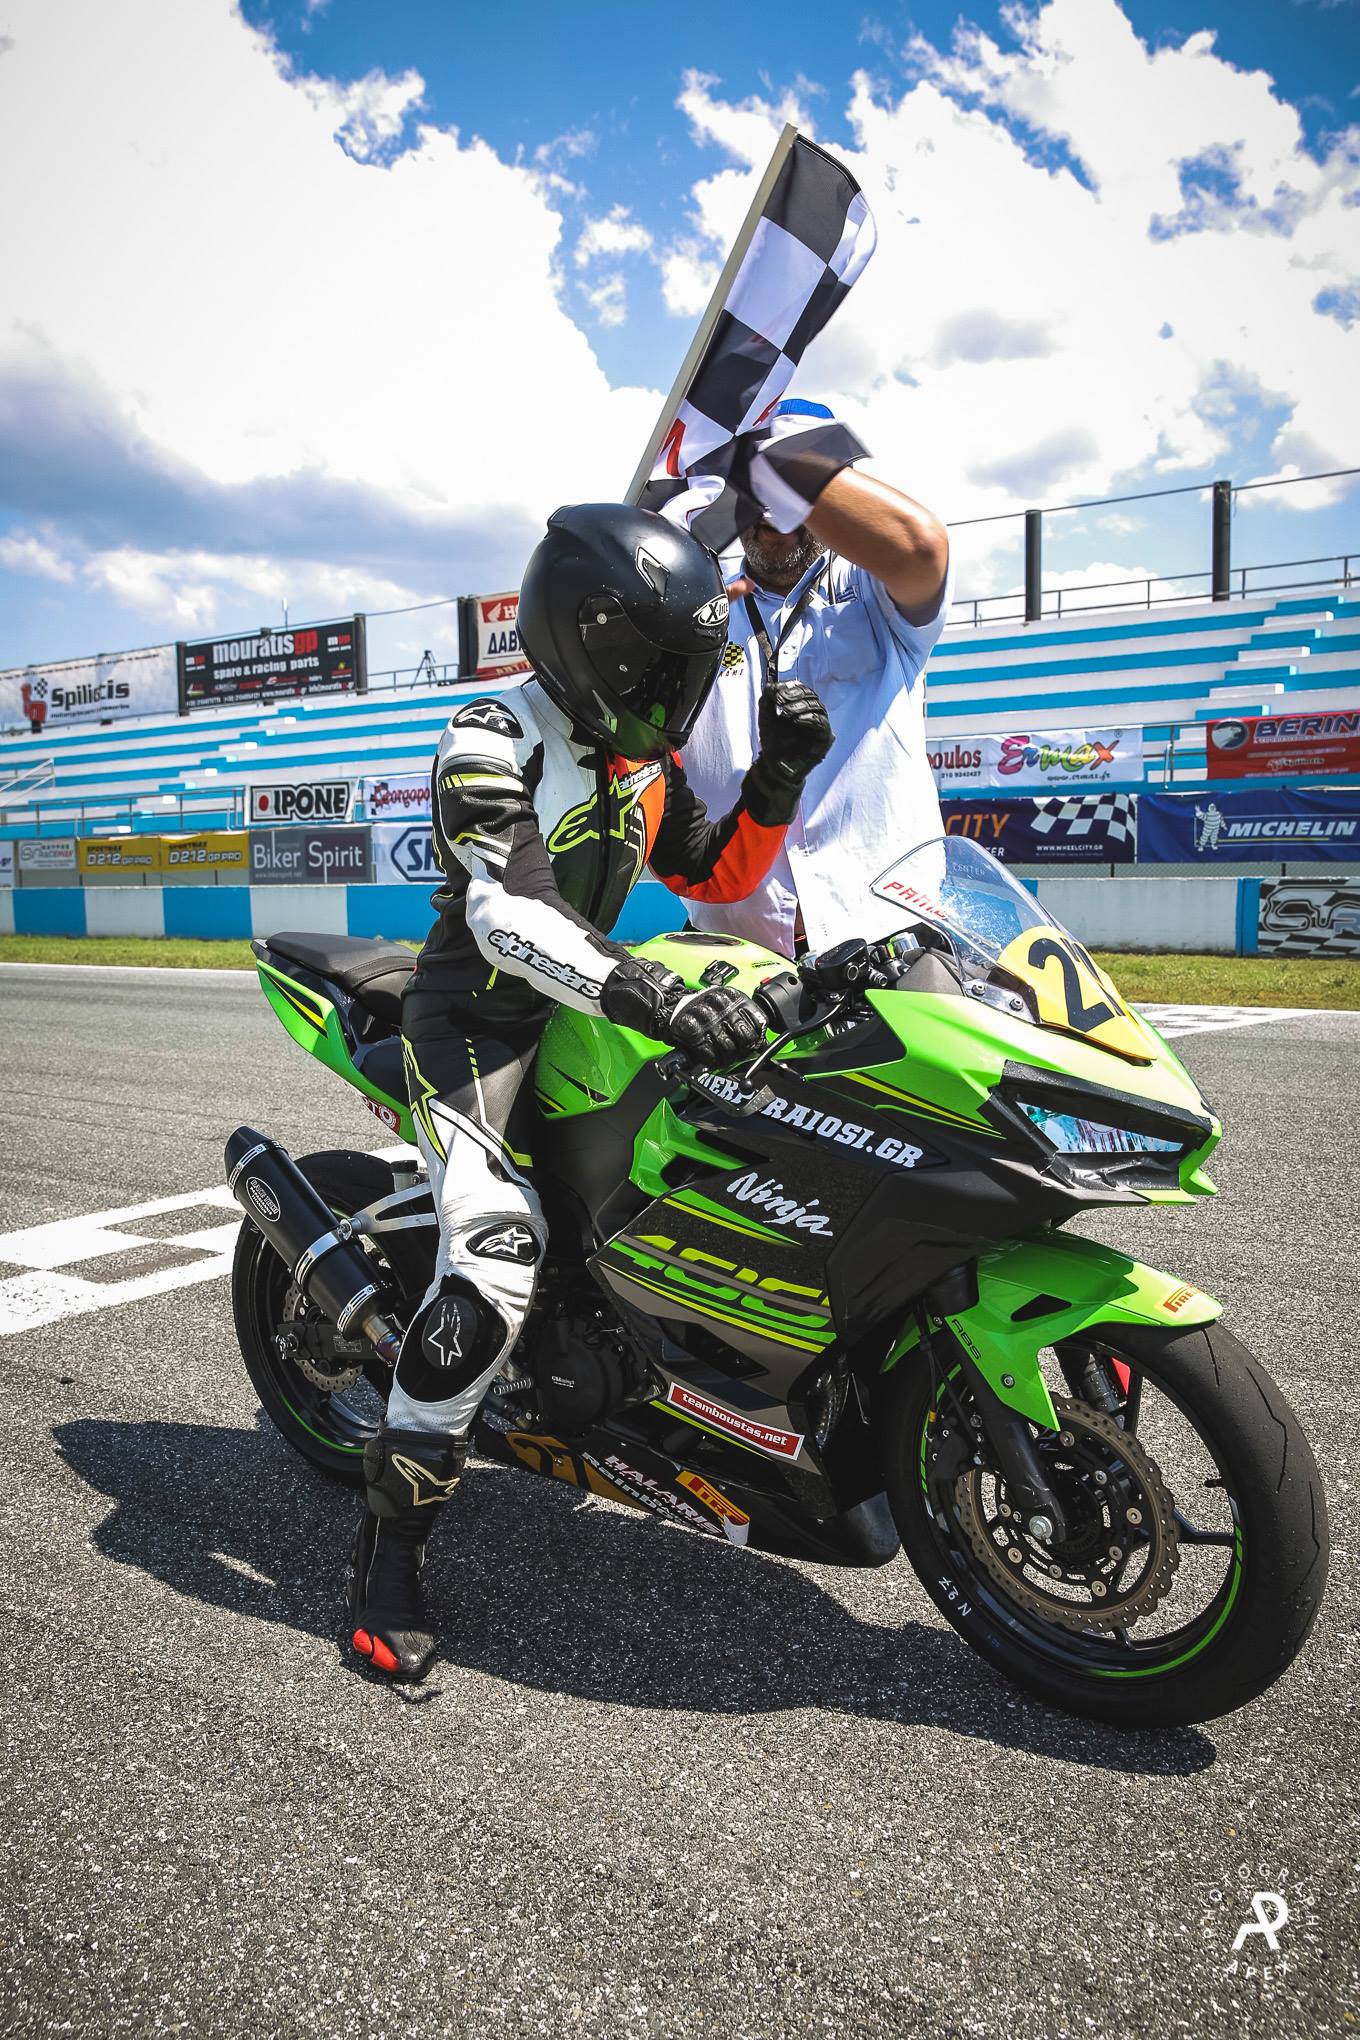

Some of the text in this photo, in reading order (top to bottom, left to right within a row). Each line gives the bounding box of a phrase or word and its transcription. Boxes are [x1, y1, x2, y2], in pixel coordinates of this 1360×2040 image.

[213, 666, 242, 680] spare
[243, 666, 251, 675] &
[252, 660, 287, 675] racing
[290, 656, 320, 671] parts
[997, 735, 1120, 775] Ermax
[274, 787, 346, 817] IPONE
[945, 813, 1010, 838] CITY
[1227, 821, 1357, 837] MICHELIN
[87, 853, 122, 866] D212
[169, 850, 206, 865] D212
[253, 831, 363, 883] Biker Spirit
[488, 929, 603, 1000] alpinestars
[726, 1172, 834, 1236] Ninja
[951, 1319, 982, 1360] ABS
[682, 1392, 788, 1447] teamboustas.net
[604, 1455, 723, 1534] HALARIS
